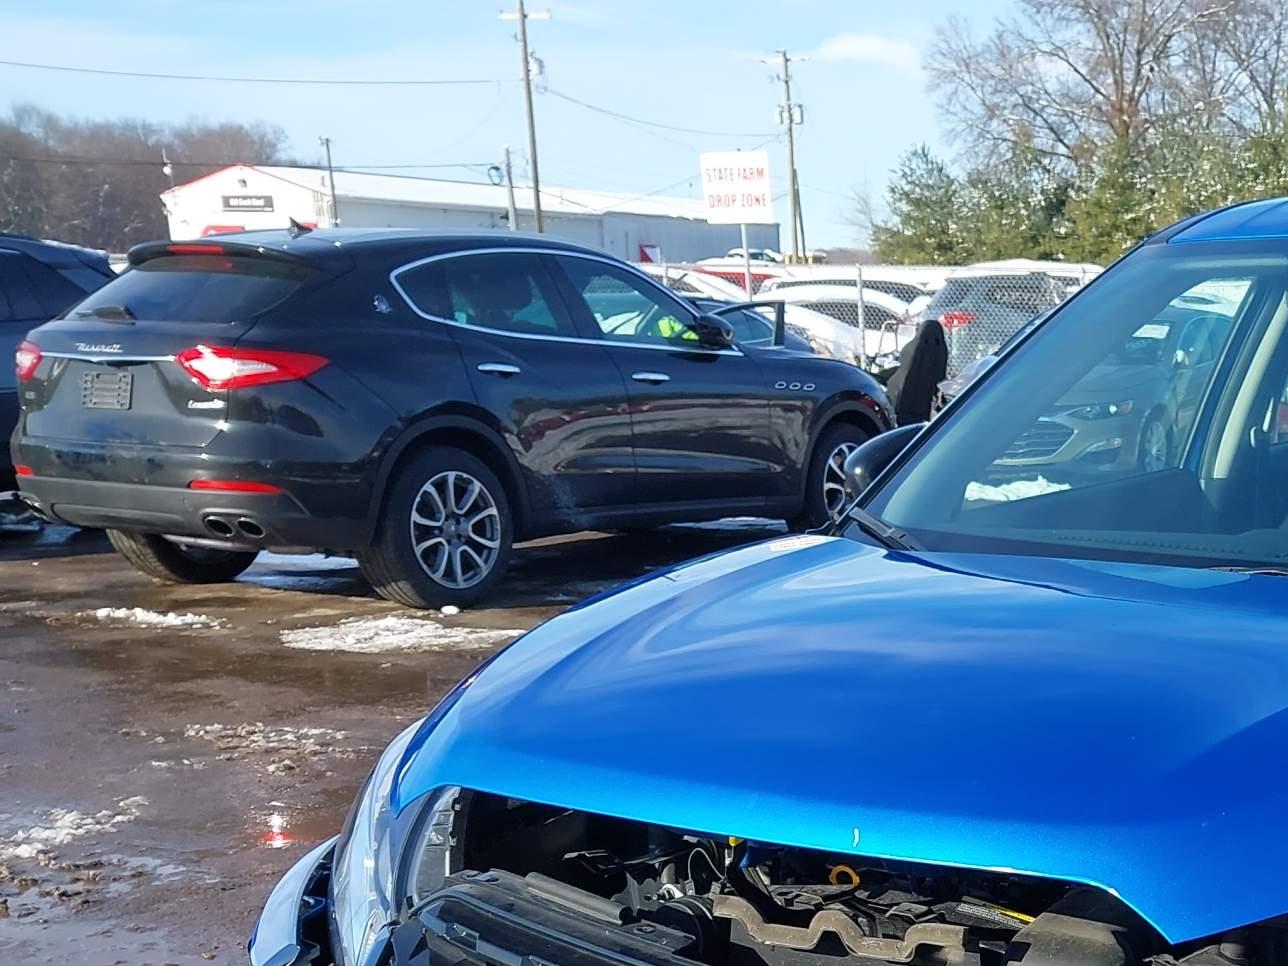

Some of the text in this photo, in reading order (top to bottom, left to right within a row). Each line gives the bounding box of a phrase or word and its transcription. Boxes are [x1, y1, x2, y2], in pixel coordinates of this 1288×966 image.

[705, 167, 764, 182] STATE FARM
[708, 192, 766, 208] DROP ZONE
